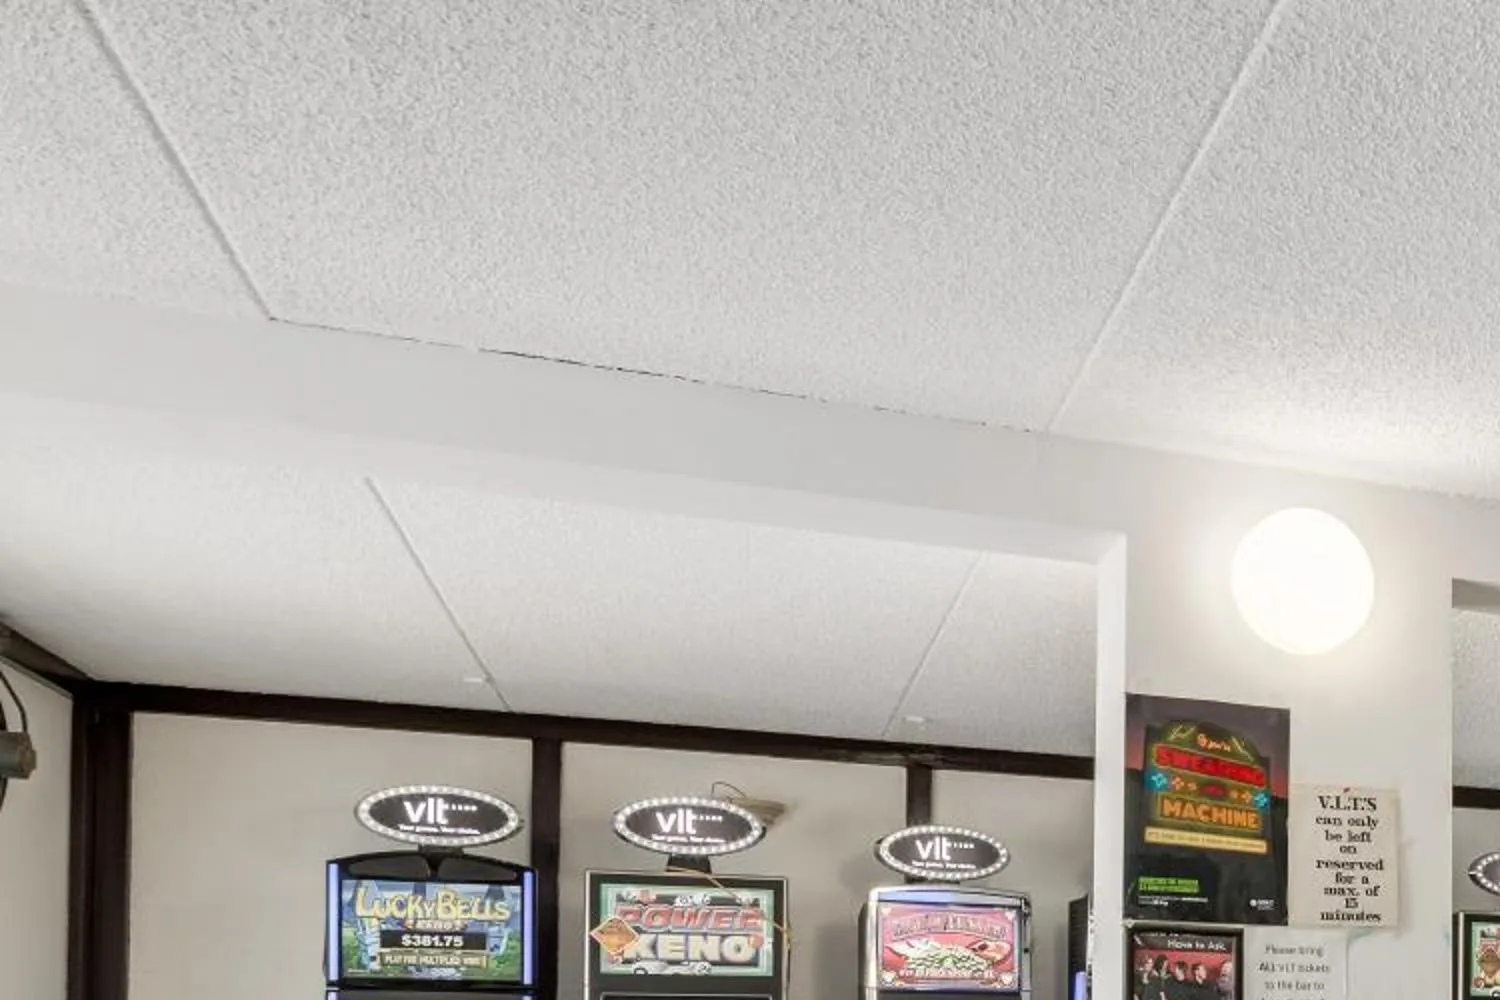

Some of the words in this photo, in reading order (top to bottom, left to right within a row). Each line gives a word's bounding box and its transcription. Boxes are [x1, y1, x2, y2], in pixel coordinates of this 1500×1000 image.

[403, 797, 449, 825] vlt
[1162, 798, 1261, 829] MACHINE
[655, 808, 697, 834] vlt
[1315, 816, 1342, 825] can
[1347, 815, 1378, 830] only
[1324, 829, 1343, 841] be
[1347, 829, 1371, 842] left
[915, 836, 952, 860] vlt
[1339, 845, 1357, 854] on
[1315, 859, 1384, 870] reserved
[1335, 872, 1355, 884] for
[1361, 875, 1369, 884] a
[1323, 887, 1361, 896] max.
[1365, 885, 1381, 896] of
[1344, 898, 1359, 908] 15
[615, 904, 763, 930] POWER
[1320, 910, 1381, 920] minutes
[401, 934, 464, 947] $381.75
[622, 933, 757, 963] KENO
[1265, 944, 1297, 954] Please
[1277, 980, 1293, 990] the
